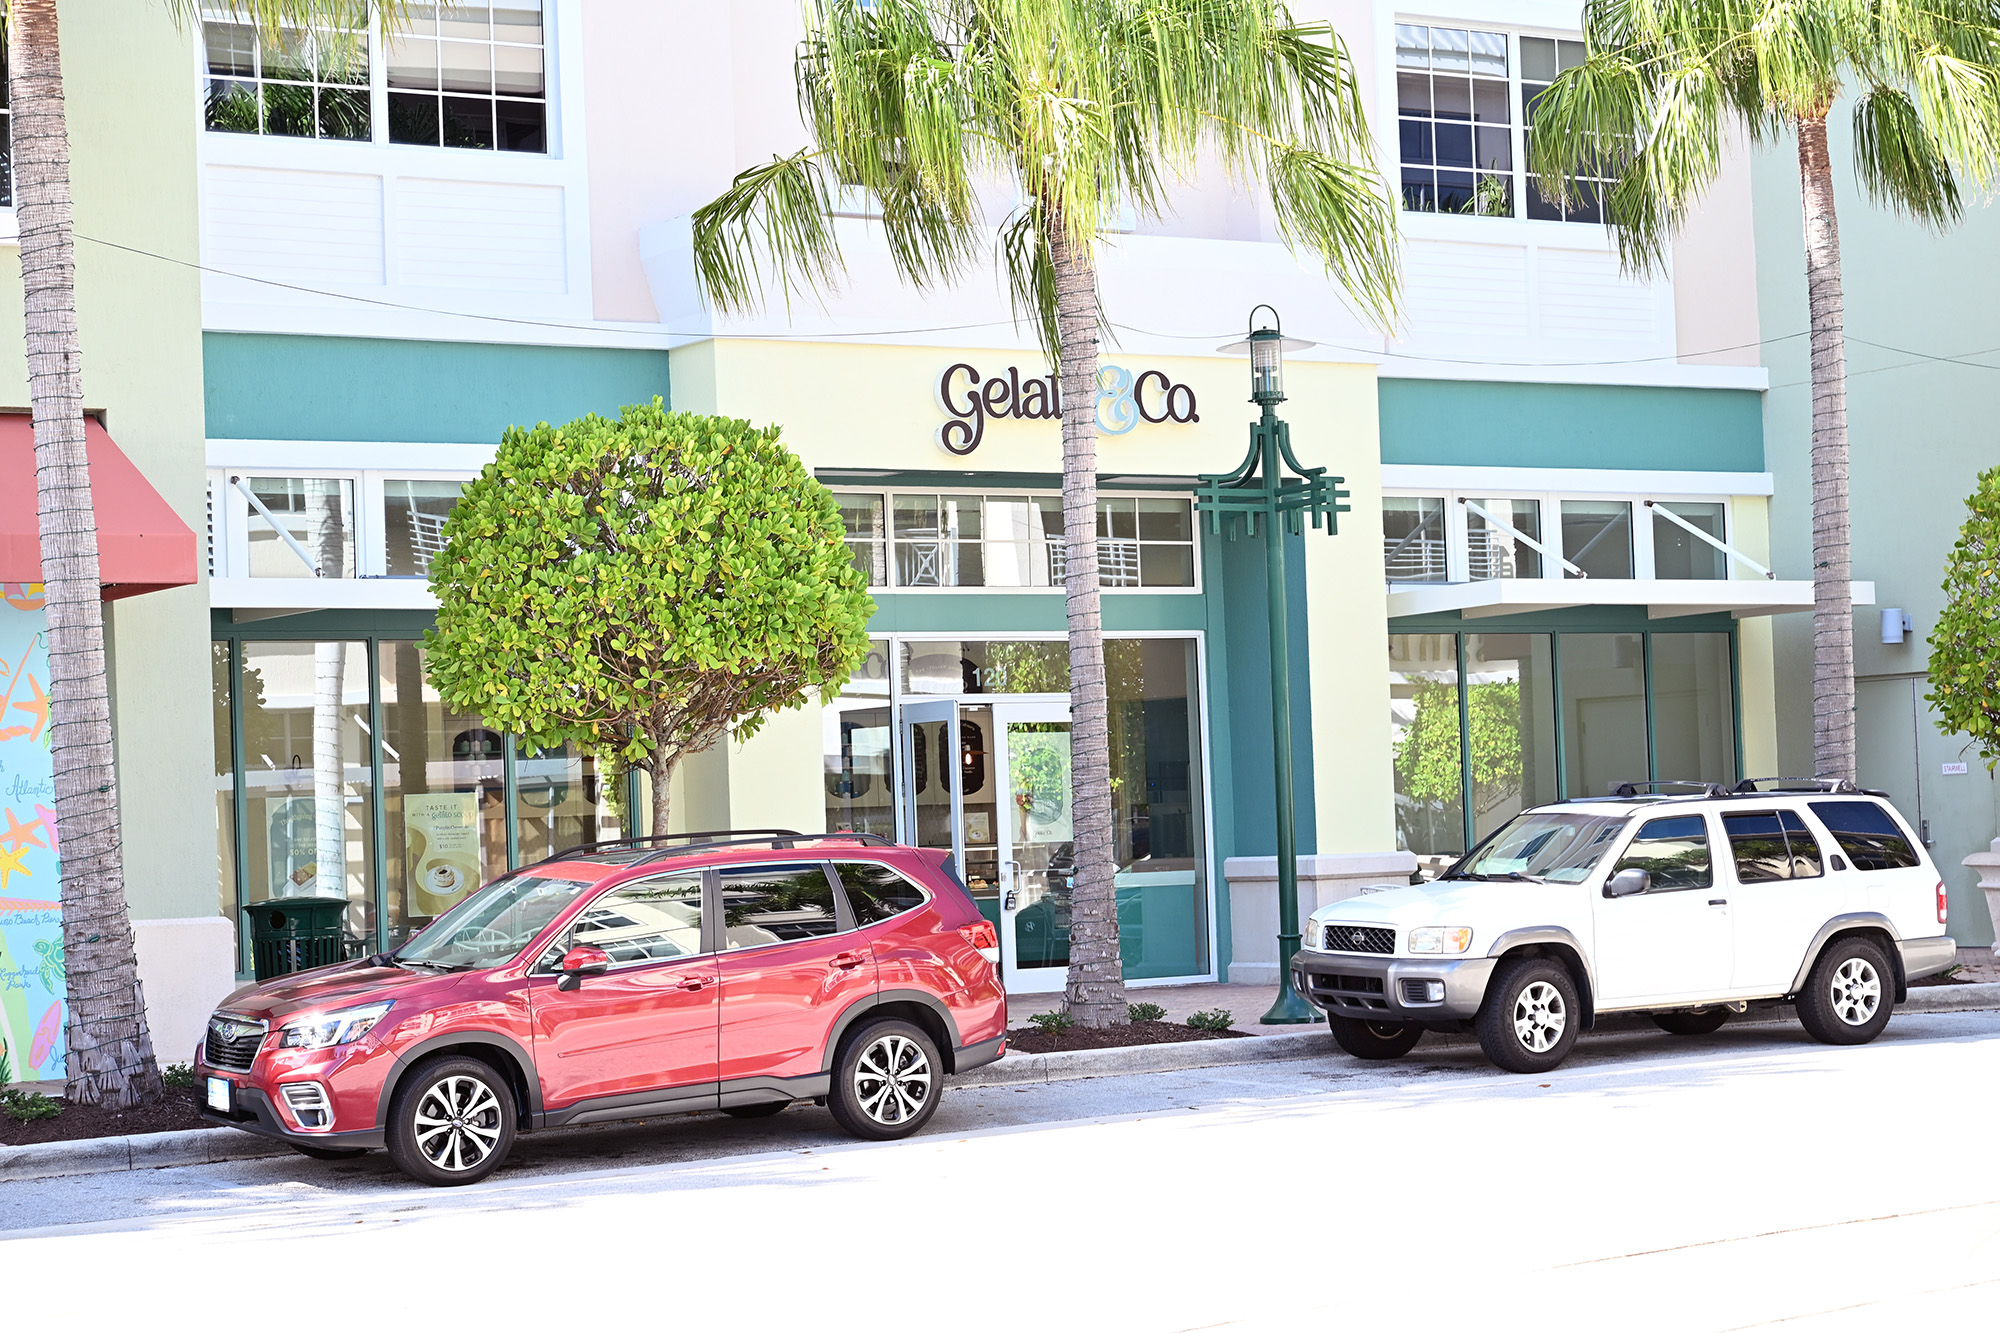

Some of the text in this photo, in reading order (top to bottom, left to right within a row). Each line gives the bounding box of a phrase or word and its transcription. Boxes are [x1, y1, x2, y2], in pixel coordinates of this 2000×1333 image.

[937, 363, 1063, 456] Gelat
[972, 667, 1007, 687] 120
[6, 774, 53, 803] Atlantic
